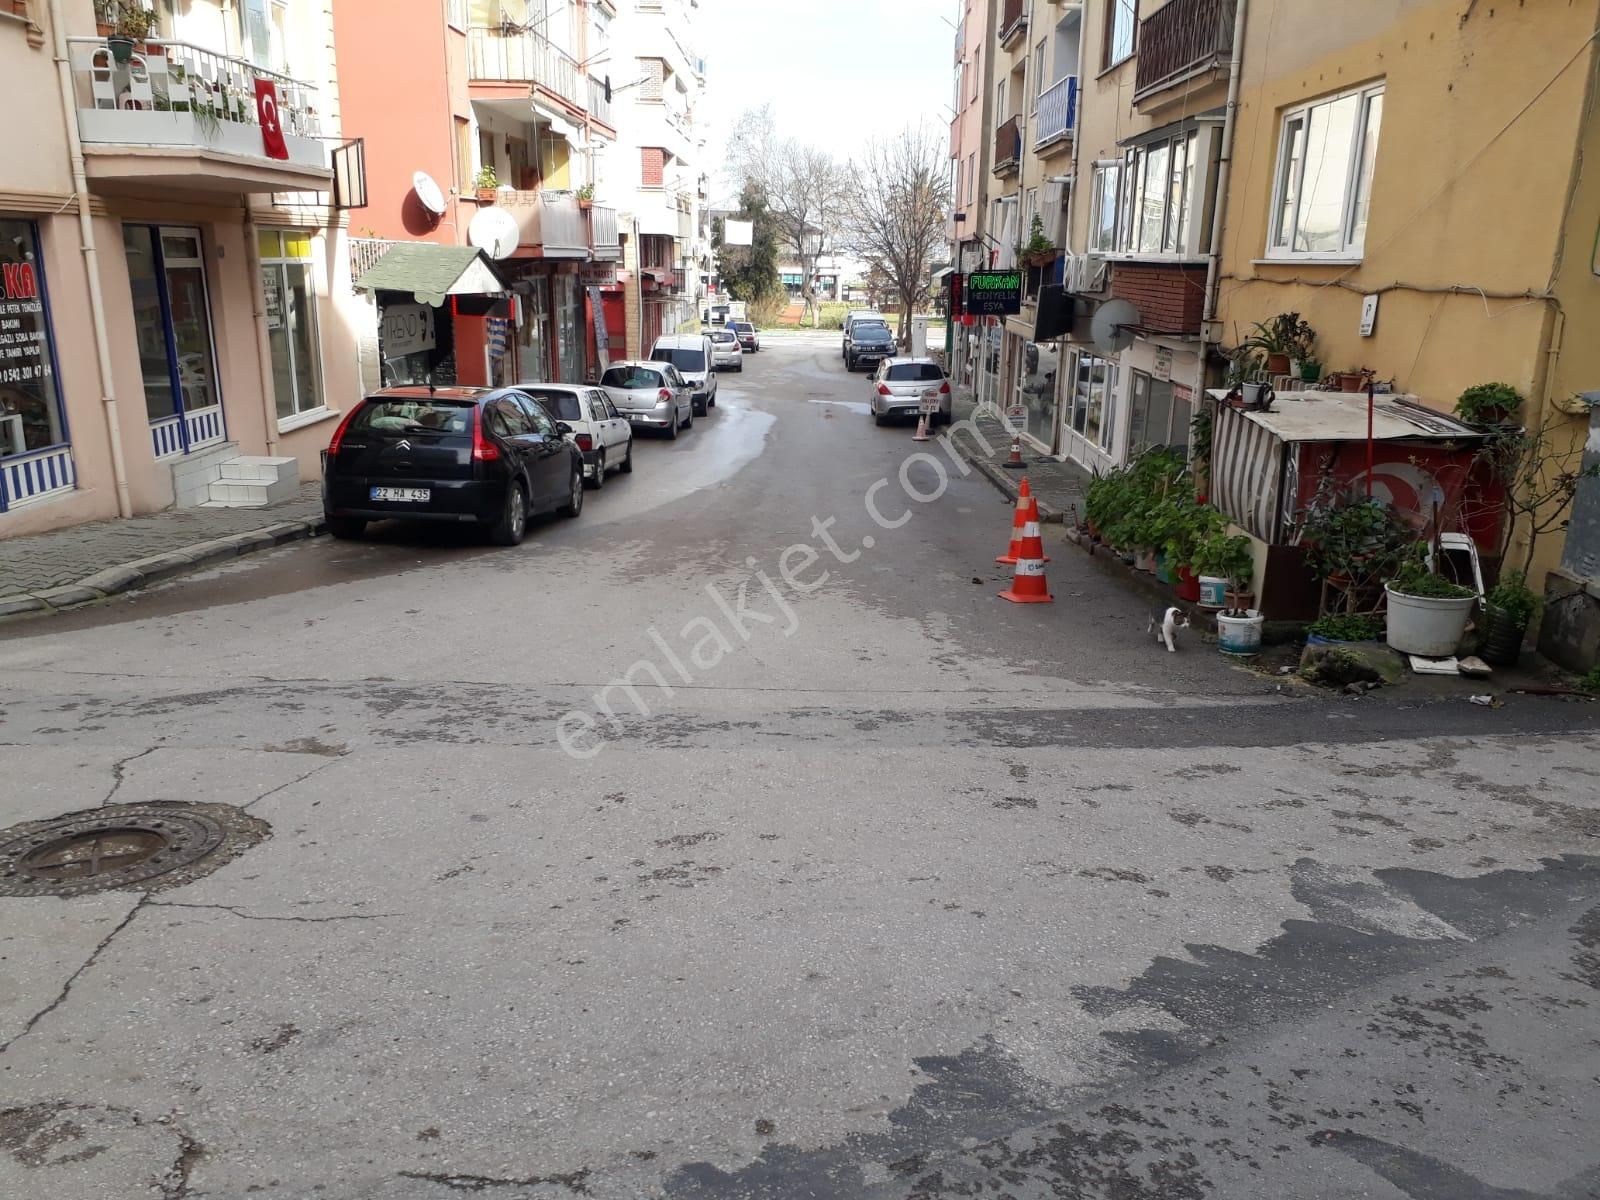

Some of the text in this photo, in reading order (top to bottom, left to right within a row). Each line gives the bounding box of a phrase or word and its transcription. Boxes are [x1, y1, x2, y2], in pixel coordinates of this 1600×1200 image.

[970, 275, 1019, 290] FURKAN
[376, 488, 429, 500] 22 HA 435
